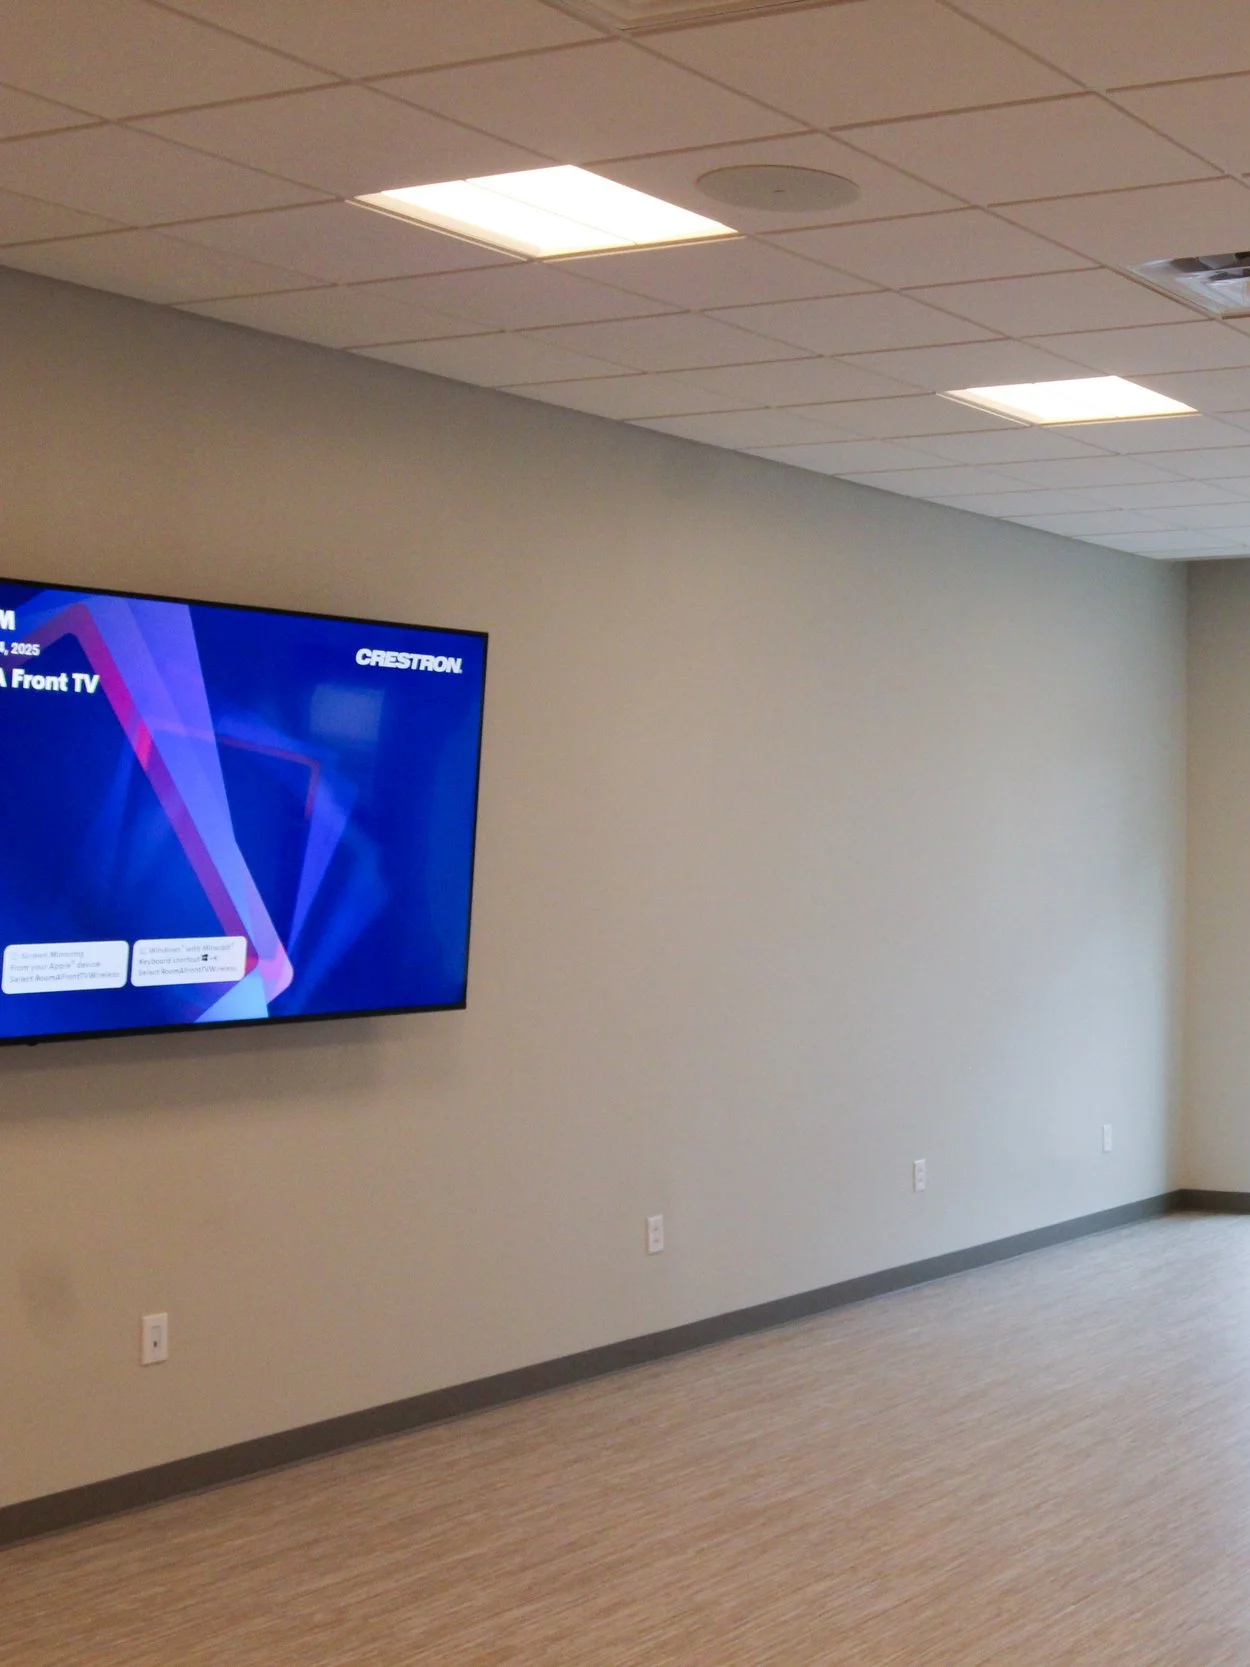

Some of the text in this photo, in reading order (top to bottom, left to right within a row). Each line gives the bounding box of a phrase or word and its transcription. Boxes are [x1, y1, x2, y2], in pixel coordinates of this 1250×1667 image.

[10, 642, 41, 656] 2025
[355, 648, 463, 674] CRESTRON
[11, 668, 69, 692] Front
[71, 672, 100, 694] TV
